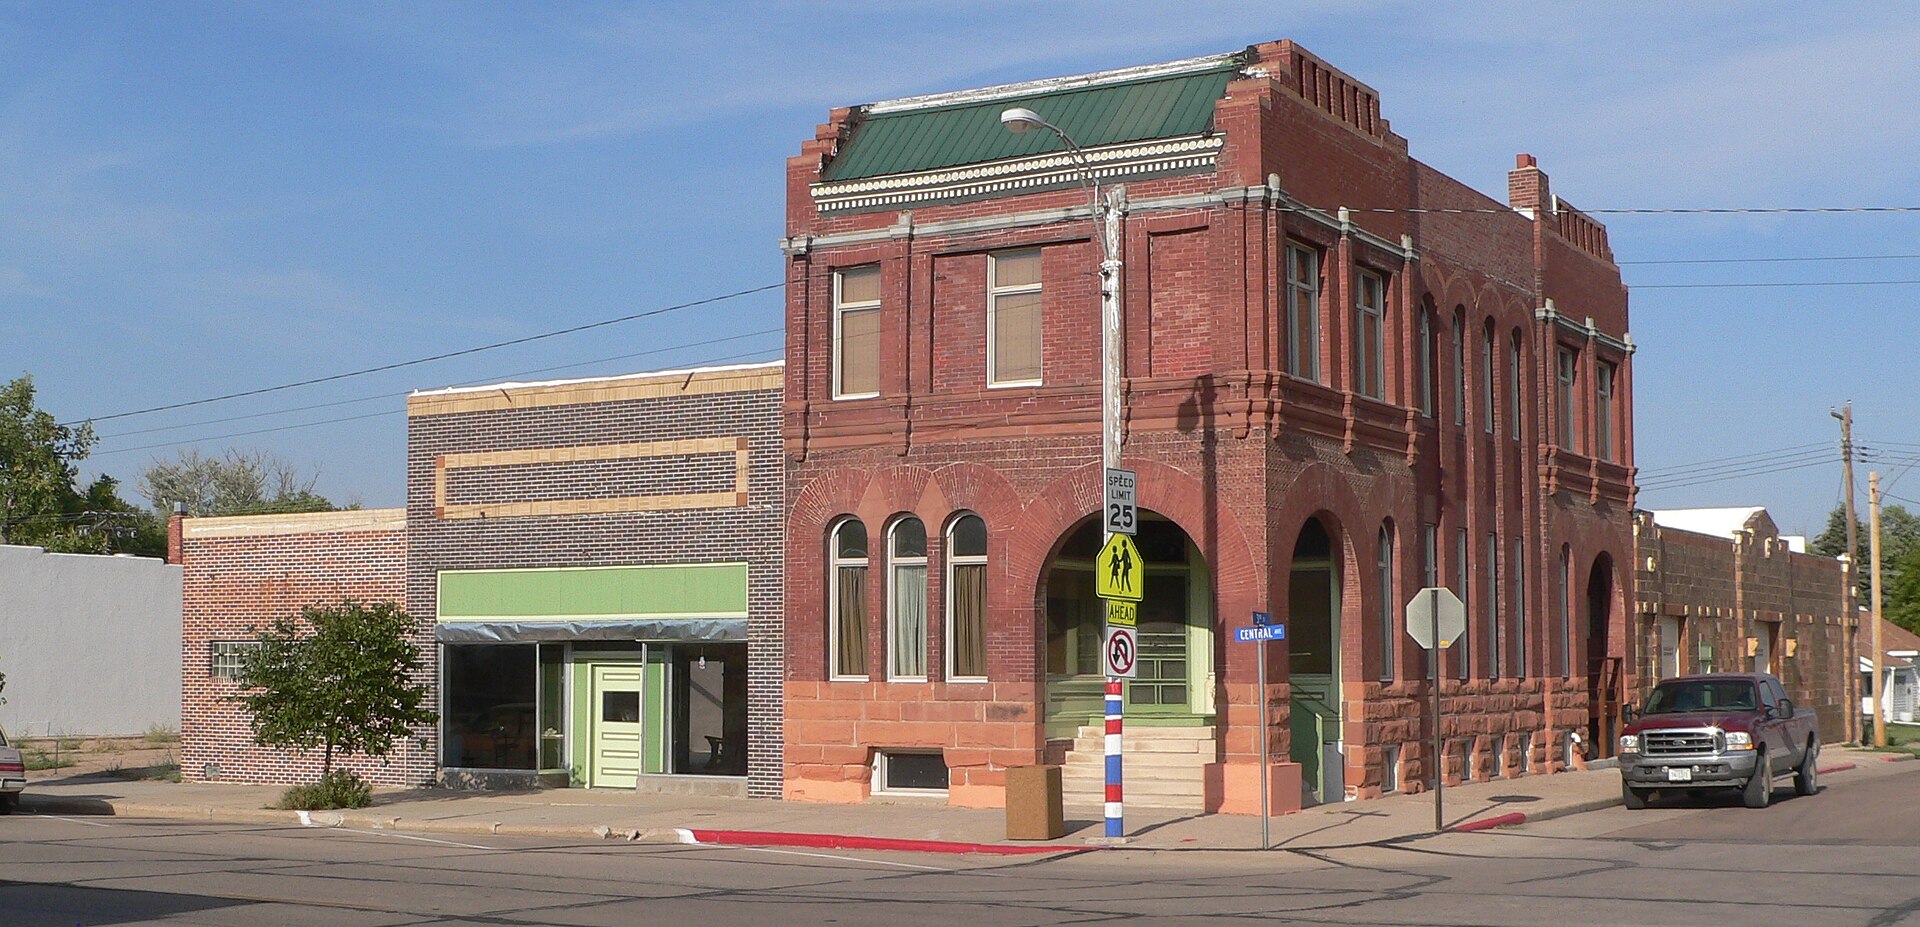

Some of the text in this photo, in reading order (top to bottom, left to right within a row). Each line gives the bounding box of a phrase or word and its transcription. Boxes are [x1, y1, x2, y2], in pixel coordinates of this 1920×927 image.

[1109, 477, 1134, 488] SPEED
[1112, 489, 1131, 500] LIMIT
[1110, 503, 1133, 528] 25
[1110, 605, 1134, 621] AHEAD
[1240, 628, 1273, 640] CENTRAL
